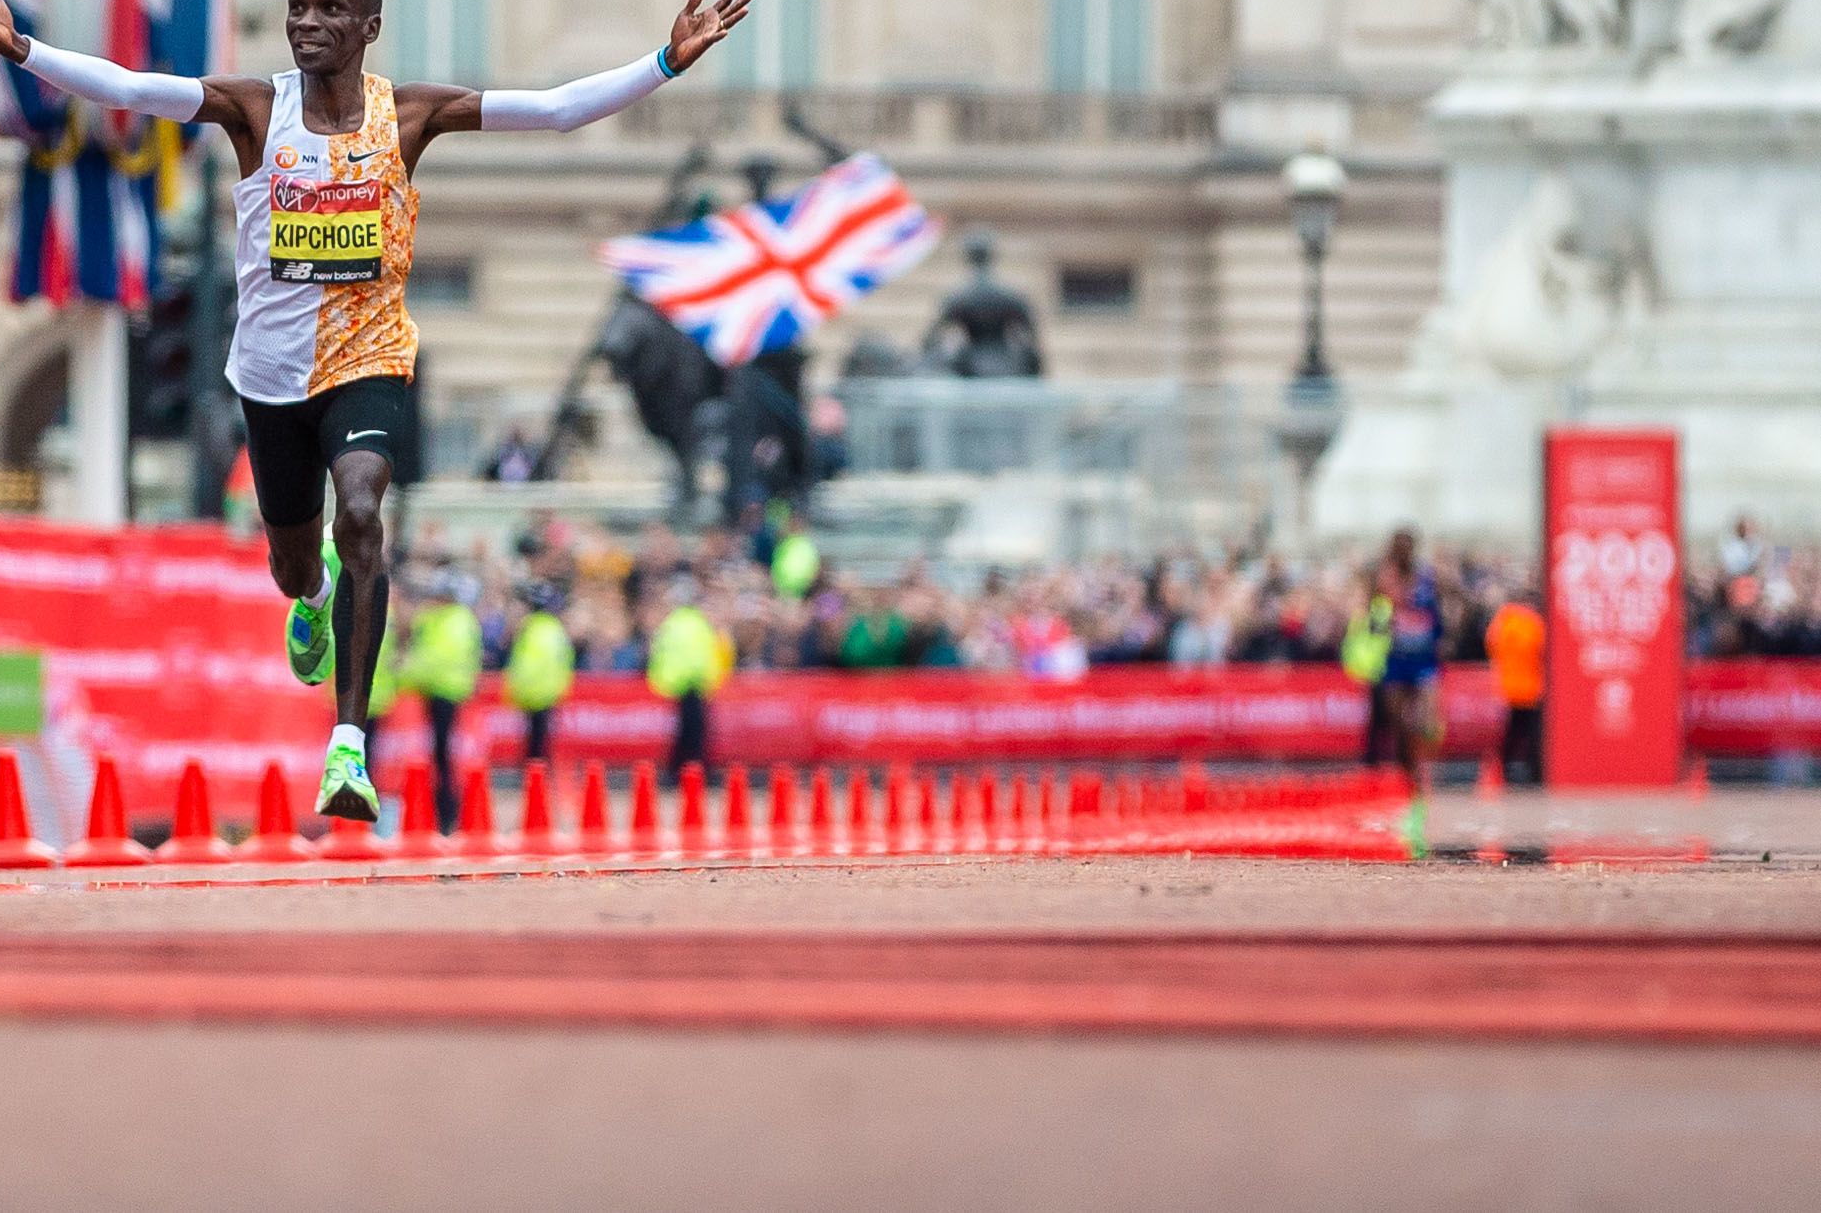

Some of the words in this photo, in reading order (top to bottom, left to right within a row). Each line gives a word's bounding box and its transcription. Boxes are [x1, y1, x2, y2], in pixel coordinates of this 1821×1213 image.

[302, 153, 319, 164] NN
[320, 185, 377, 203] money
[275, 223, 378, 249] KIPCHOGE
[313, 272, 333, 280] new
[334, 270, 372, 280] balance
